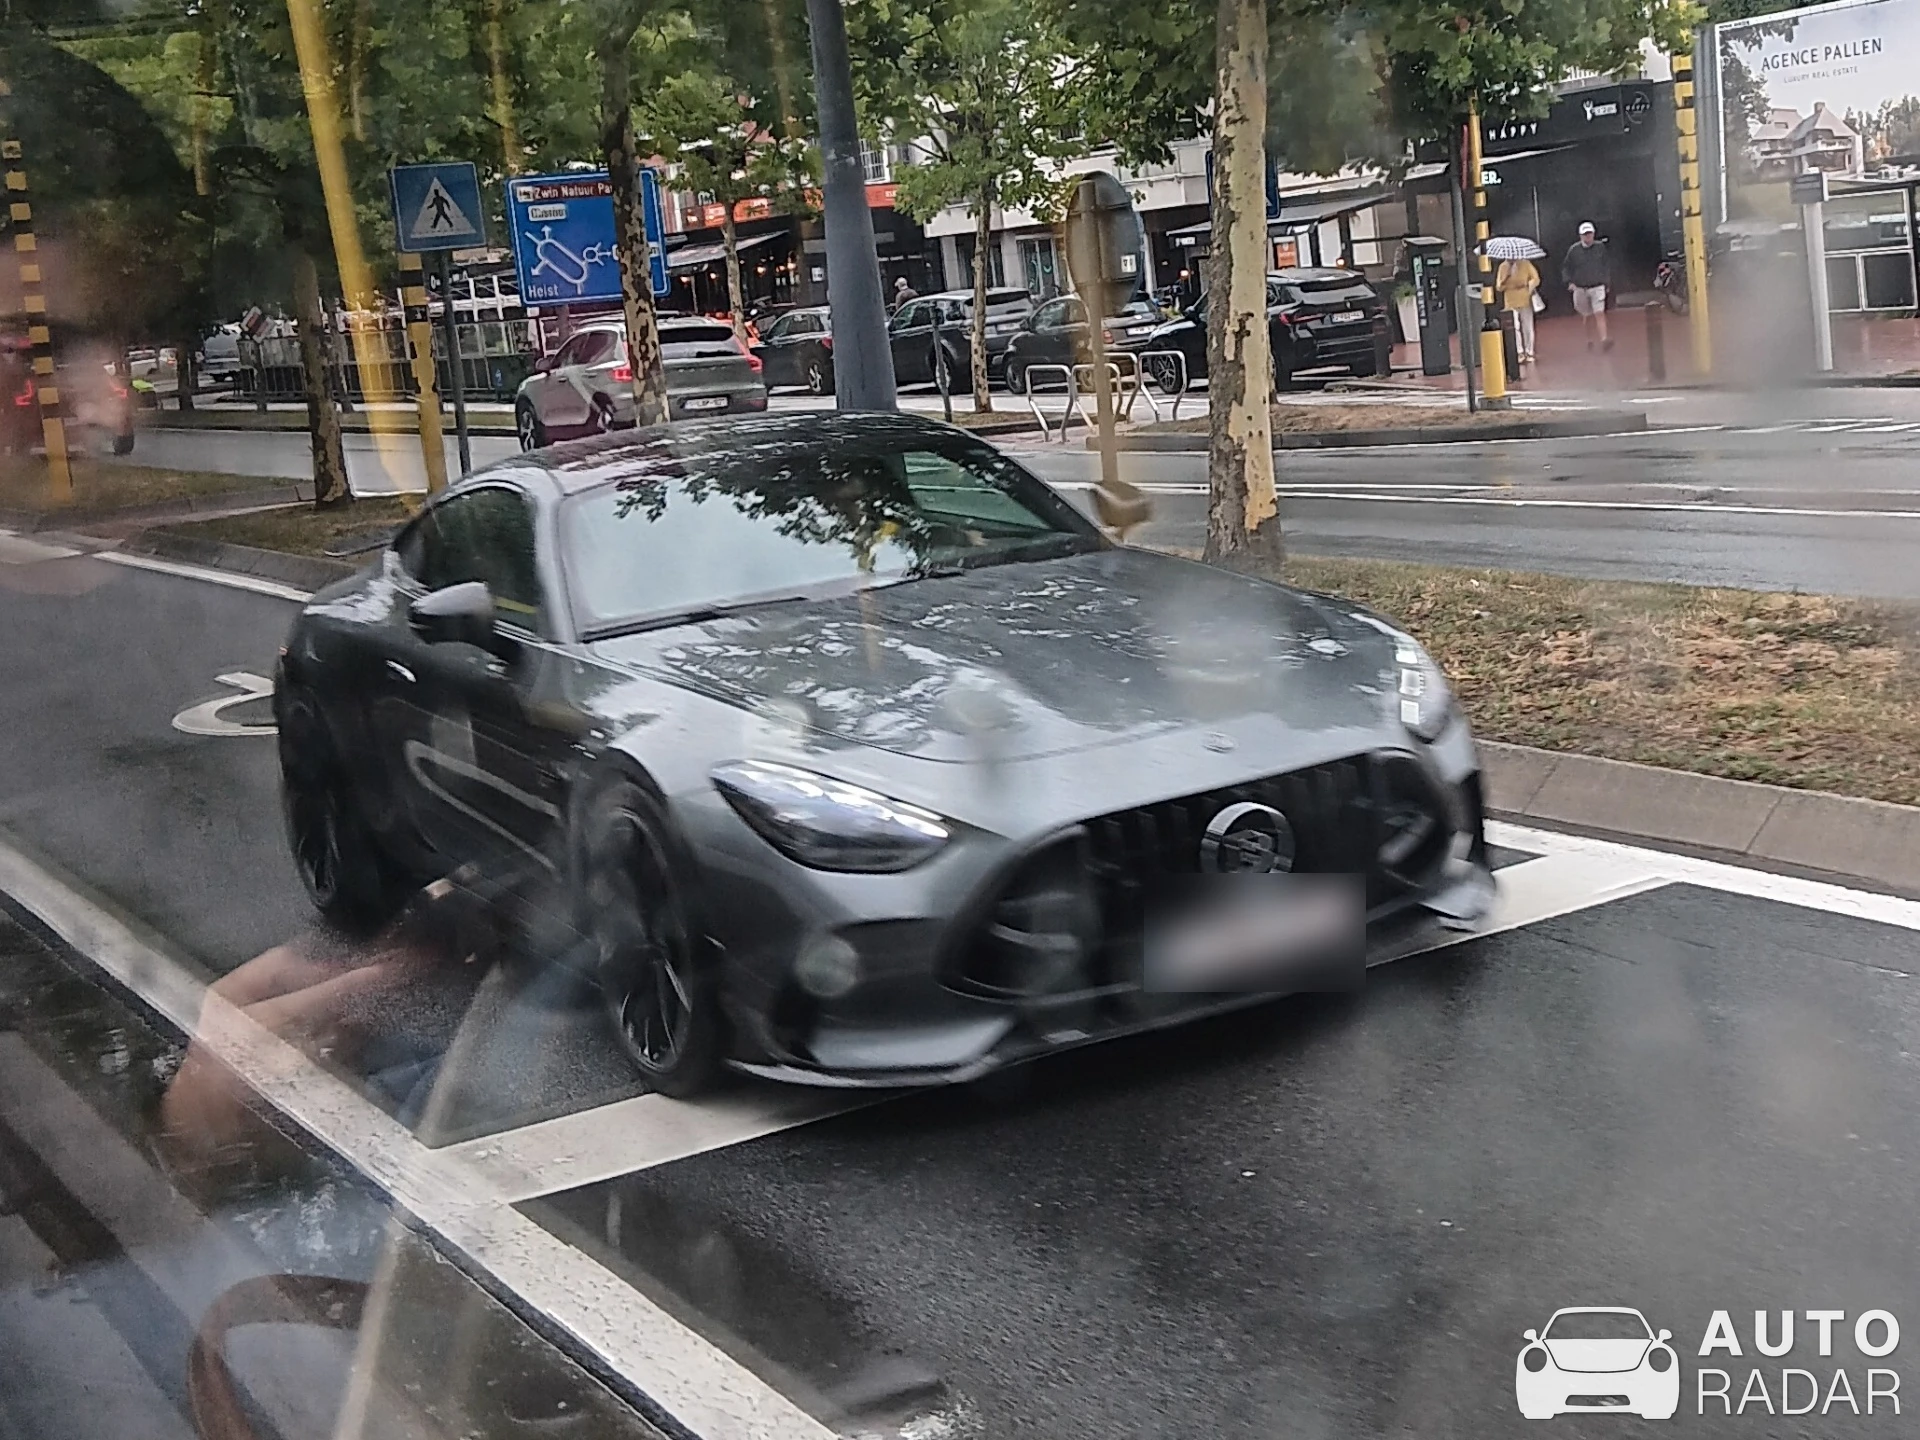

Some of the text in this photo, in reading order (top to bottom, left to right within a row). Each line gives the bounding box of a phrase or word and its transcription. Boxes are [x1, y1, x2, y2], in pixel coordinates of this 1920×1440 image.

[1761, 38, 1882, 72] AGENCE PALLEN
[1784, 66, 1858, 84] LUXURY REAL ESTATE
[534, 186, 558, 200] Zwin
[561, 184, 594, 198] Natuur
[528, 285, 559, 298] Heist
